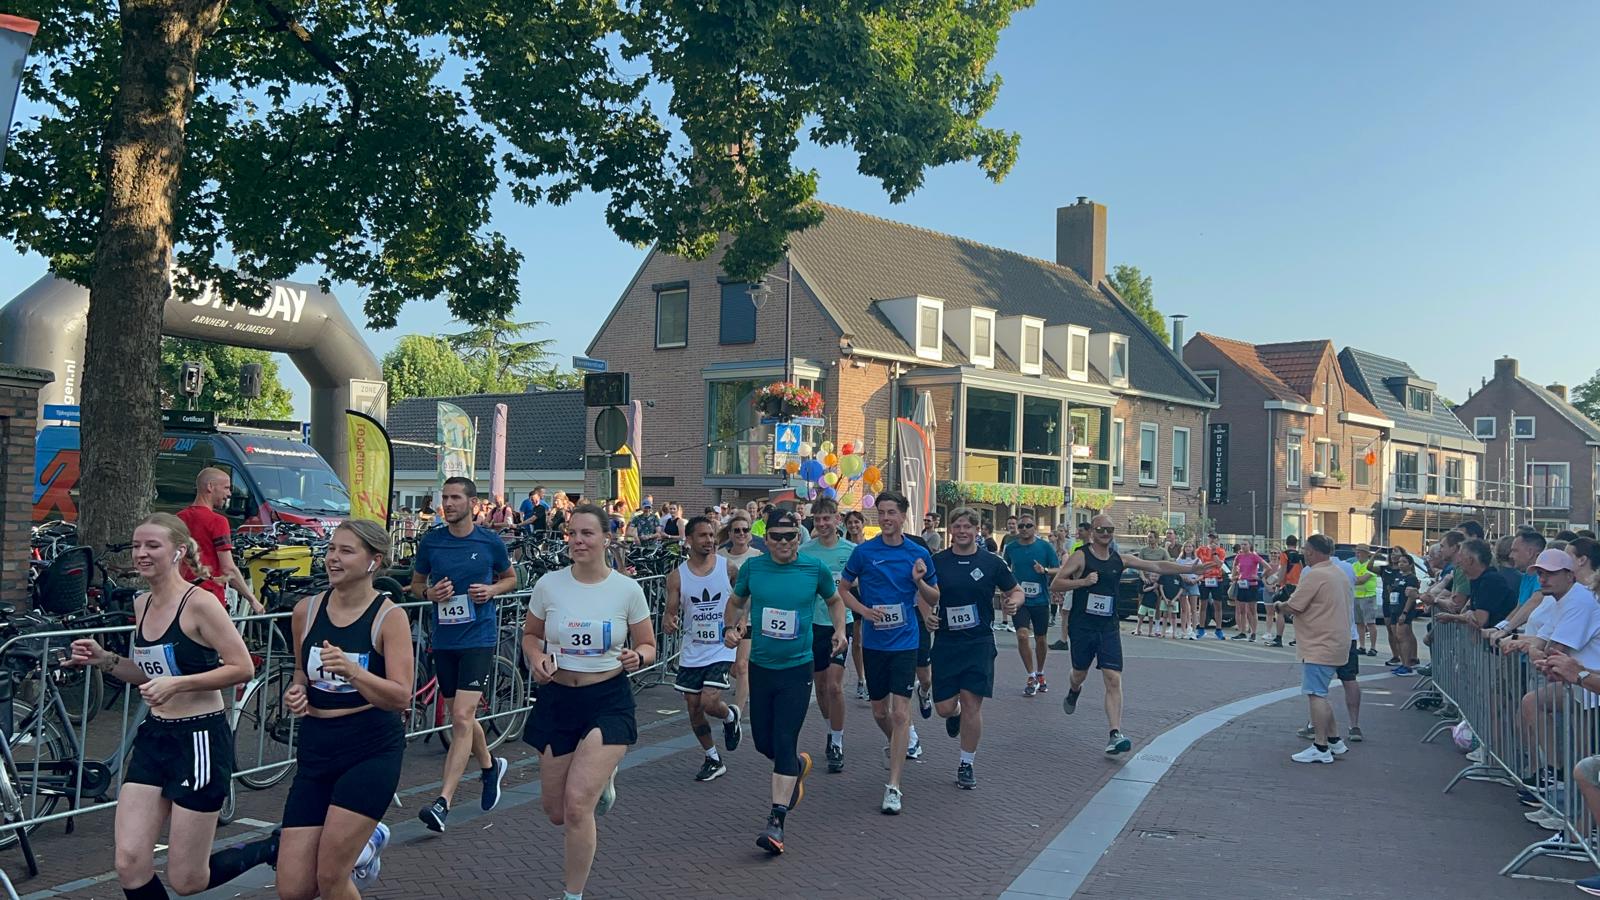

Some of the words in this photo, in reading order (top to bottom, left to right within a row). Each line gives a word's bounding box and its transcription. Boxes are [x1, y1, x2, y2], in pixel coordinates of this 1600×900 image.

[191, 315, 230, 328] ARNHEM
[233, 322, 276, 336] NIJMEGEN
[361, 385, 376, 393] ZONE
[1216, 434, 1222, 445] DE
[442, 605, 465, 617] 143
[1094, 602, 1105, 610] 26
[693, 611, 723, 621] adidas
[951, 613, 971, 624] 183
[771, 619, 787, 631] 52
[571, 633, 592, 646] 38
[697, 630, 715, 639] 186
[138, 661, 164, 675] 166
